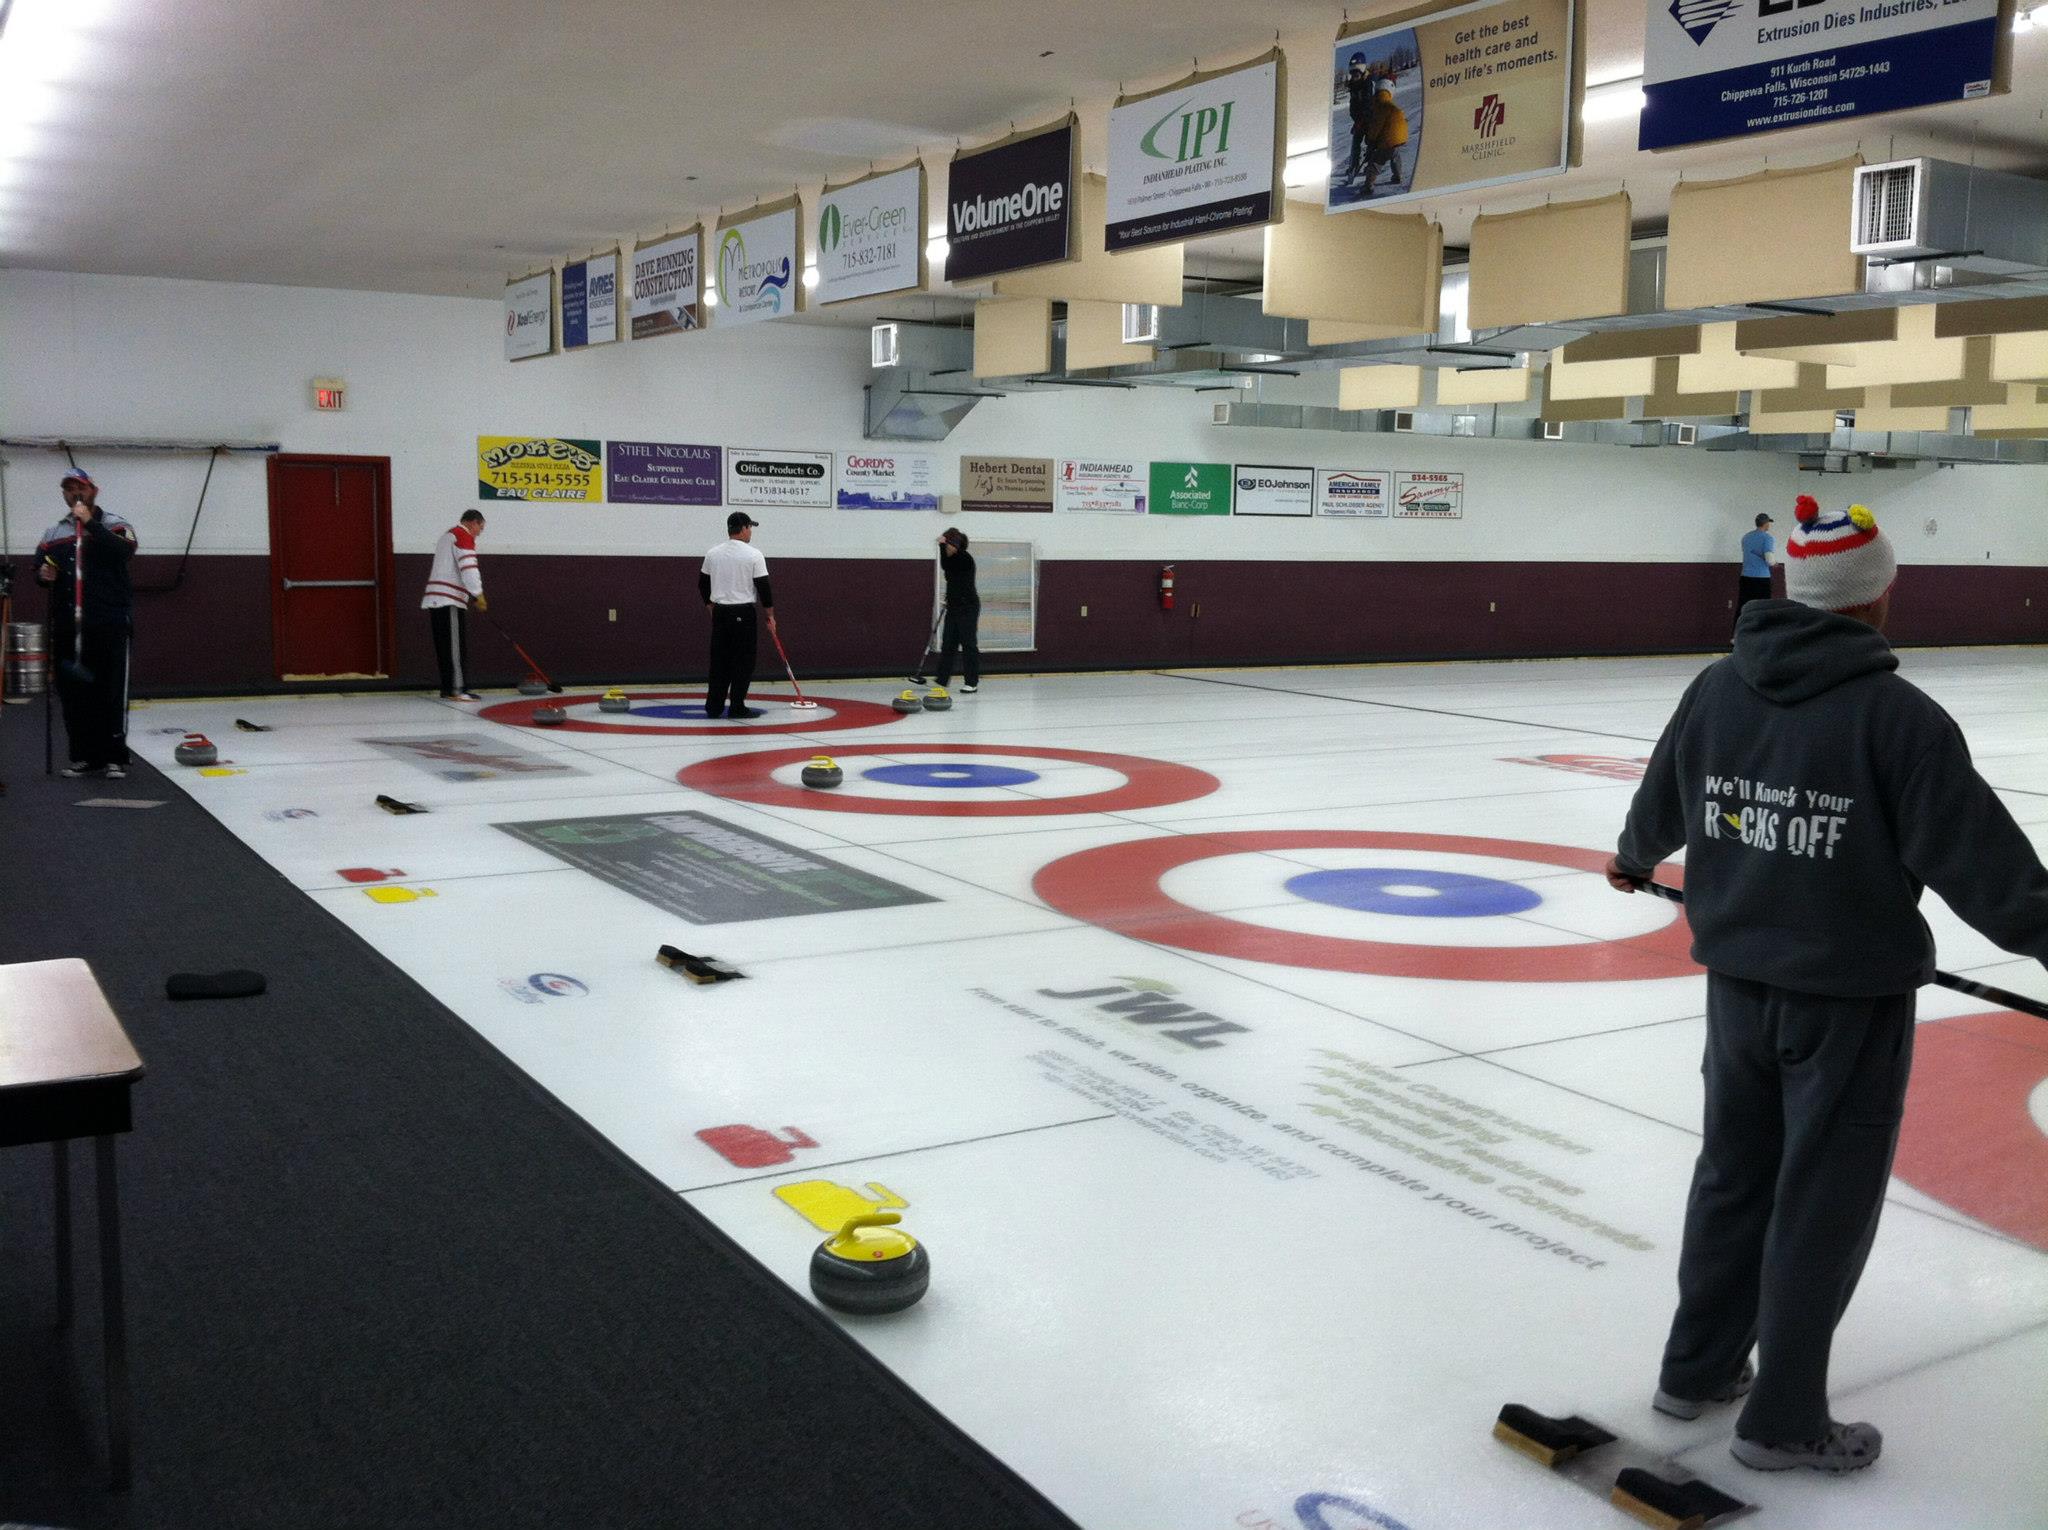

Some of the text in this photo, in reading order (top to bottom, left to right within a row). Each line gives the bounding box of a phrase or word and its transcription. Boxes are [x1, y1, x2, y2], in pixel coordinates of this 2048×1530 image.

[1455, 15, 1530, 44] Get the best
[1757, 20, 1820, 44] Extrusion
[1824, 12, 1856, 31] Dies
[1445, 31, 1538, 66] health care and
[1430, 48, 1558, 88] enjoy life's moments.
[1770, 55, 1836, 78] 911 Kurth Road
[1721, 86, 1763, 103] Chippewa
[1790, 71, 1837, 89] Wisconsin
[1747, 101, 1855, 128] www.extrusiondies.com
[1175, 101, 1235, 163] IPI
[1461, 136, 1516, 154] MARSHFIELD
[1143, 167, 1184, 185] INDIANHEAD
[1185, 159, 1212, 176] PLATING
[952, 182, 1063, 234] VolumeOne
[635, 258, 655, 279] DAVE
[634, 266, 694, 300] CONSTRUCTION
[619, 443, 711, 459] STIFEL NICOLAUS
[847, 455, 895, 469] GORDY'S
[491, 471, 590, 486] 715-514-5555
[740, 464, 821, 476] Office Products Co.
[846, 469, 895, 477] County Market
[970, 462, 1046, 475] Hebert Dental
[1079, 463, 1133, 473] INDIANHEAD
[496, 488, 587, 499] EAU CLAIRE
[1170, 490, 1211, 500] Associated
[1705, 775, 1854, 812] We'll Knock Your
[1787, 815, 1847, 859] OFF
[1108, 1050, 1137, 1061] we
[1272, 1123, 1325, 1142] and
[1318, 1143, 1430, 1192] complete
[1423, 1192, 1498, 1221] your
[1489, 1223, 1607, 1270] project
